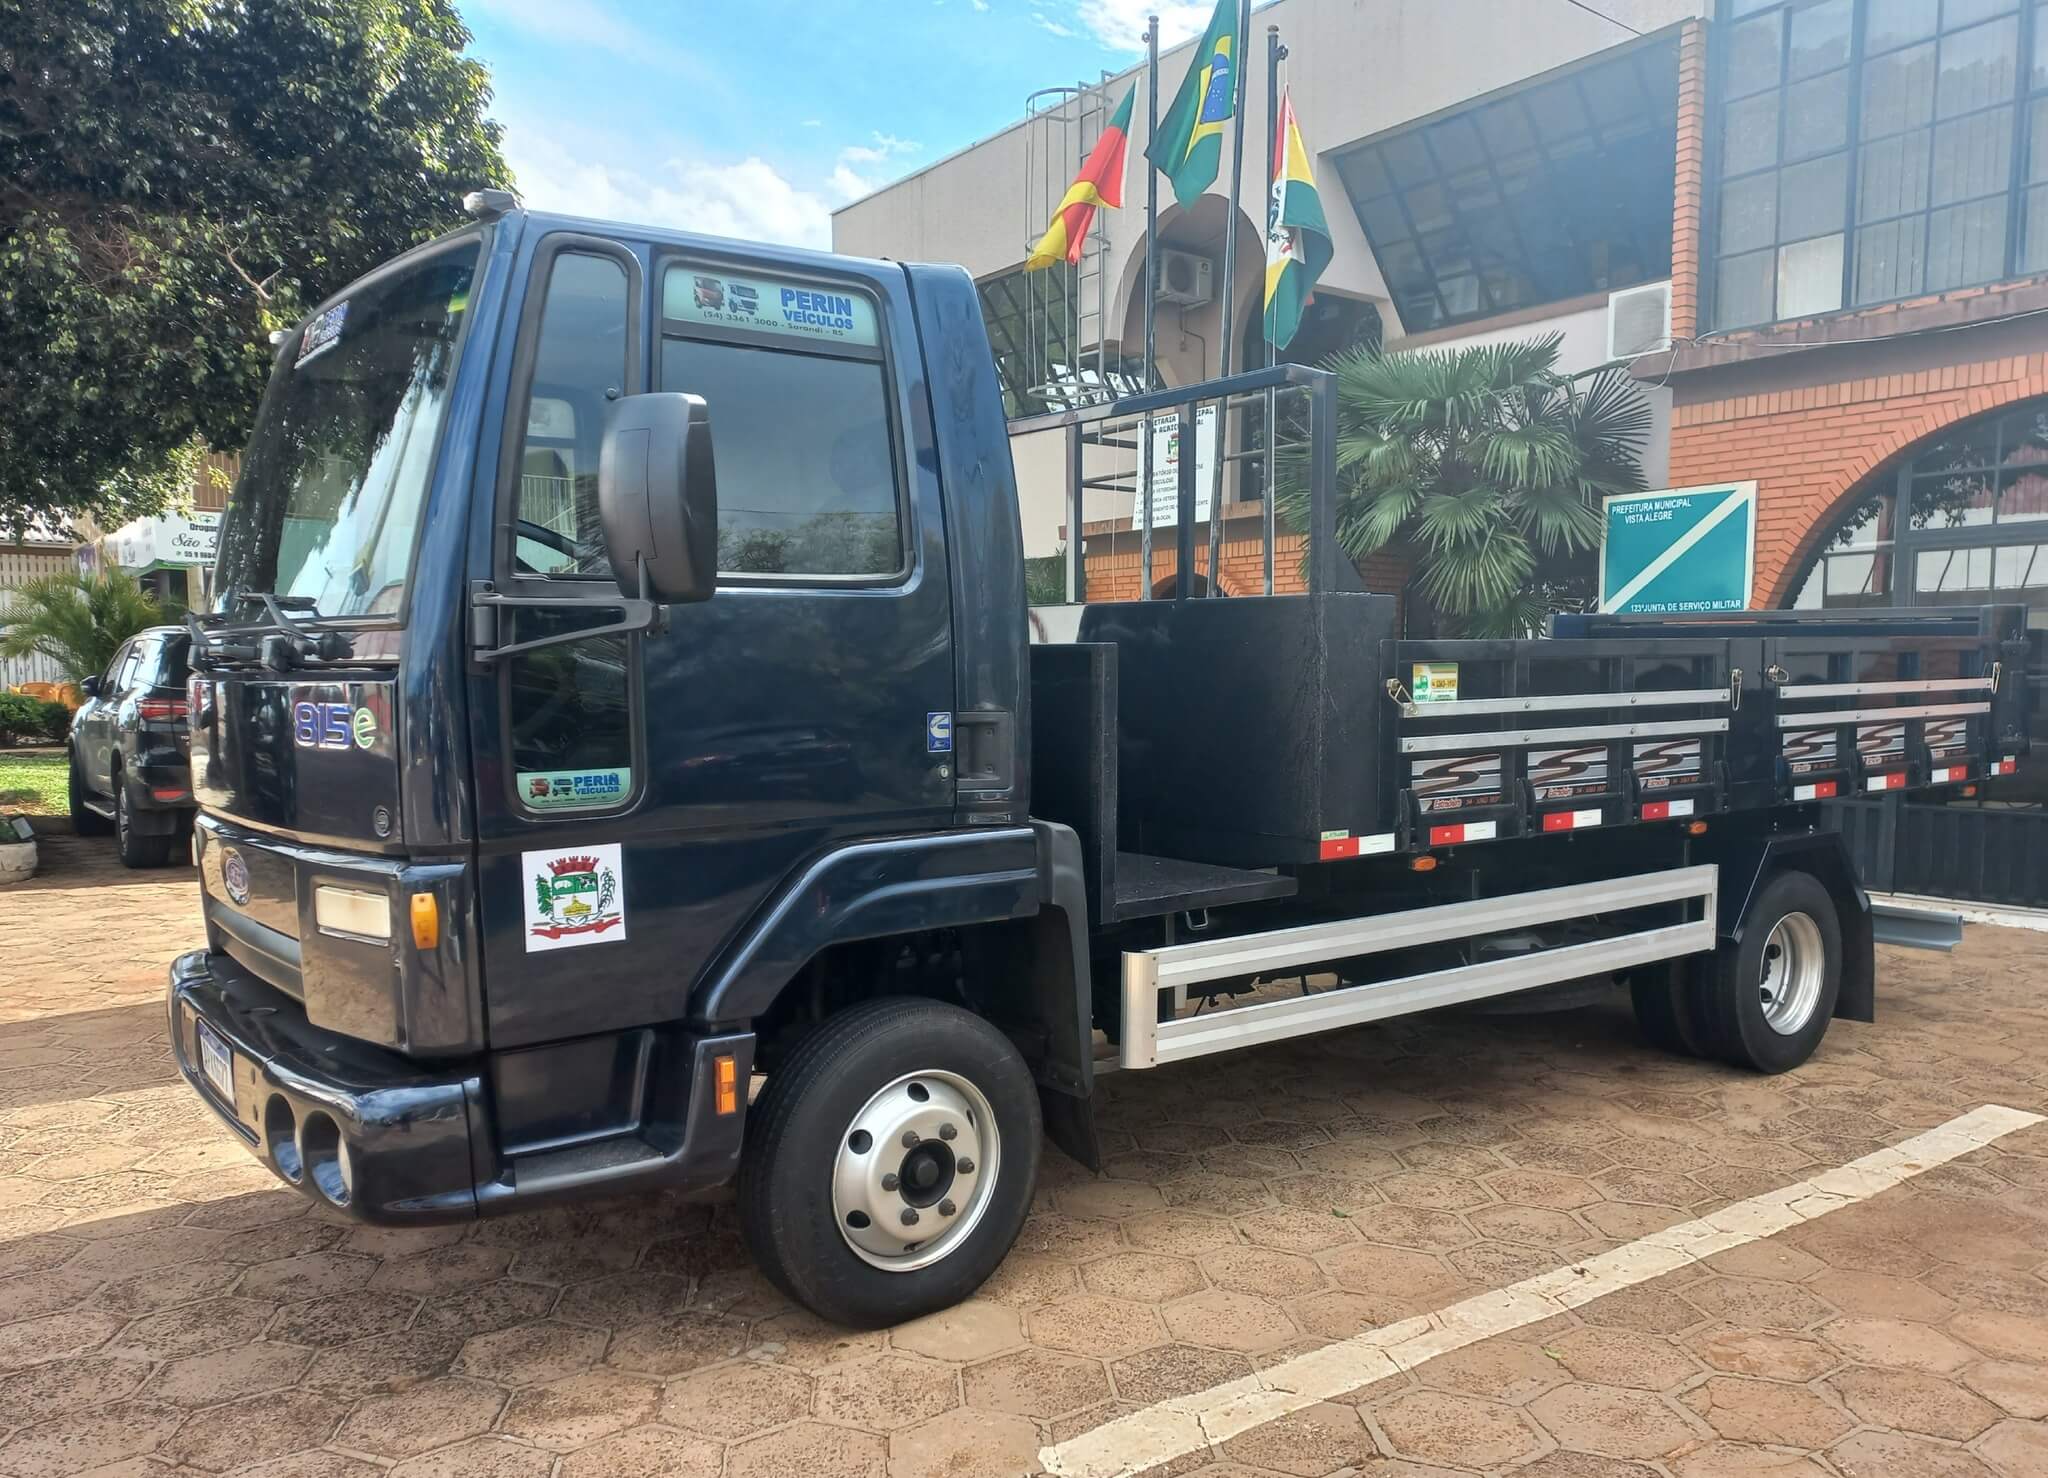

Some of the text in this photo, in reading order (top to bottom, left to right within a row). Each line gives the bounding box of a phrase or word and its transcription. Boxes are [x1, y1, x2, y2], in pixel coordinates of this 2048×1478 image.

[780, 287, 853, 317] PERIN
[782, 309, 854, 331] VEÍCULOS
[787, 322, 824, 334] Sarandi
[1612, 498, 1692, 514] PREFEITURA MUNICIPAL
[1625, 511, 1673, 524] VISTA ALEGRE
[189, 523, 217, 532] Drogar
[171, 533, 201, 548] São
[1667, 602, 1678, 611] DE
[1679, 601, 1711, 611] SERVIÇO
[1712, 599, 1741, 609] MILITAR
[574, 774, 620, 786] PERIN
[574, 786, 619, 795] VEÍCULOS
